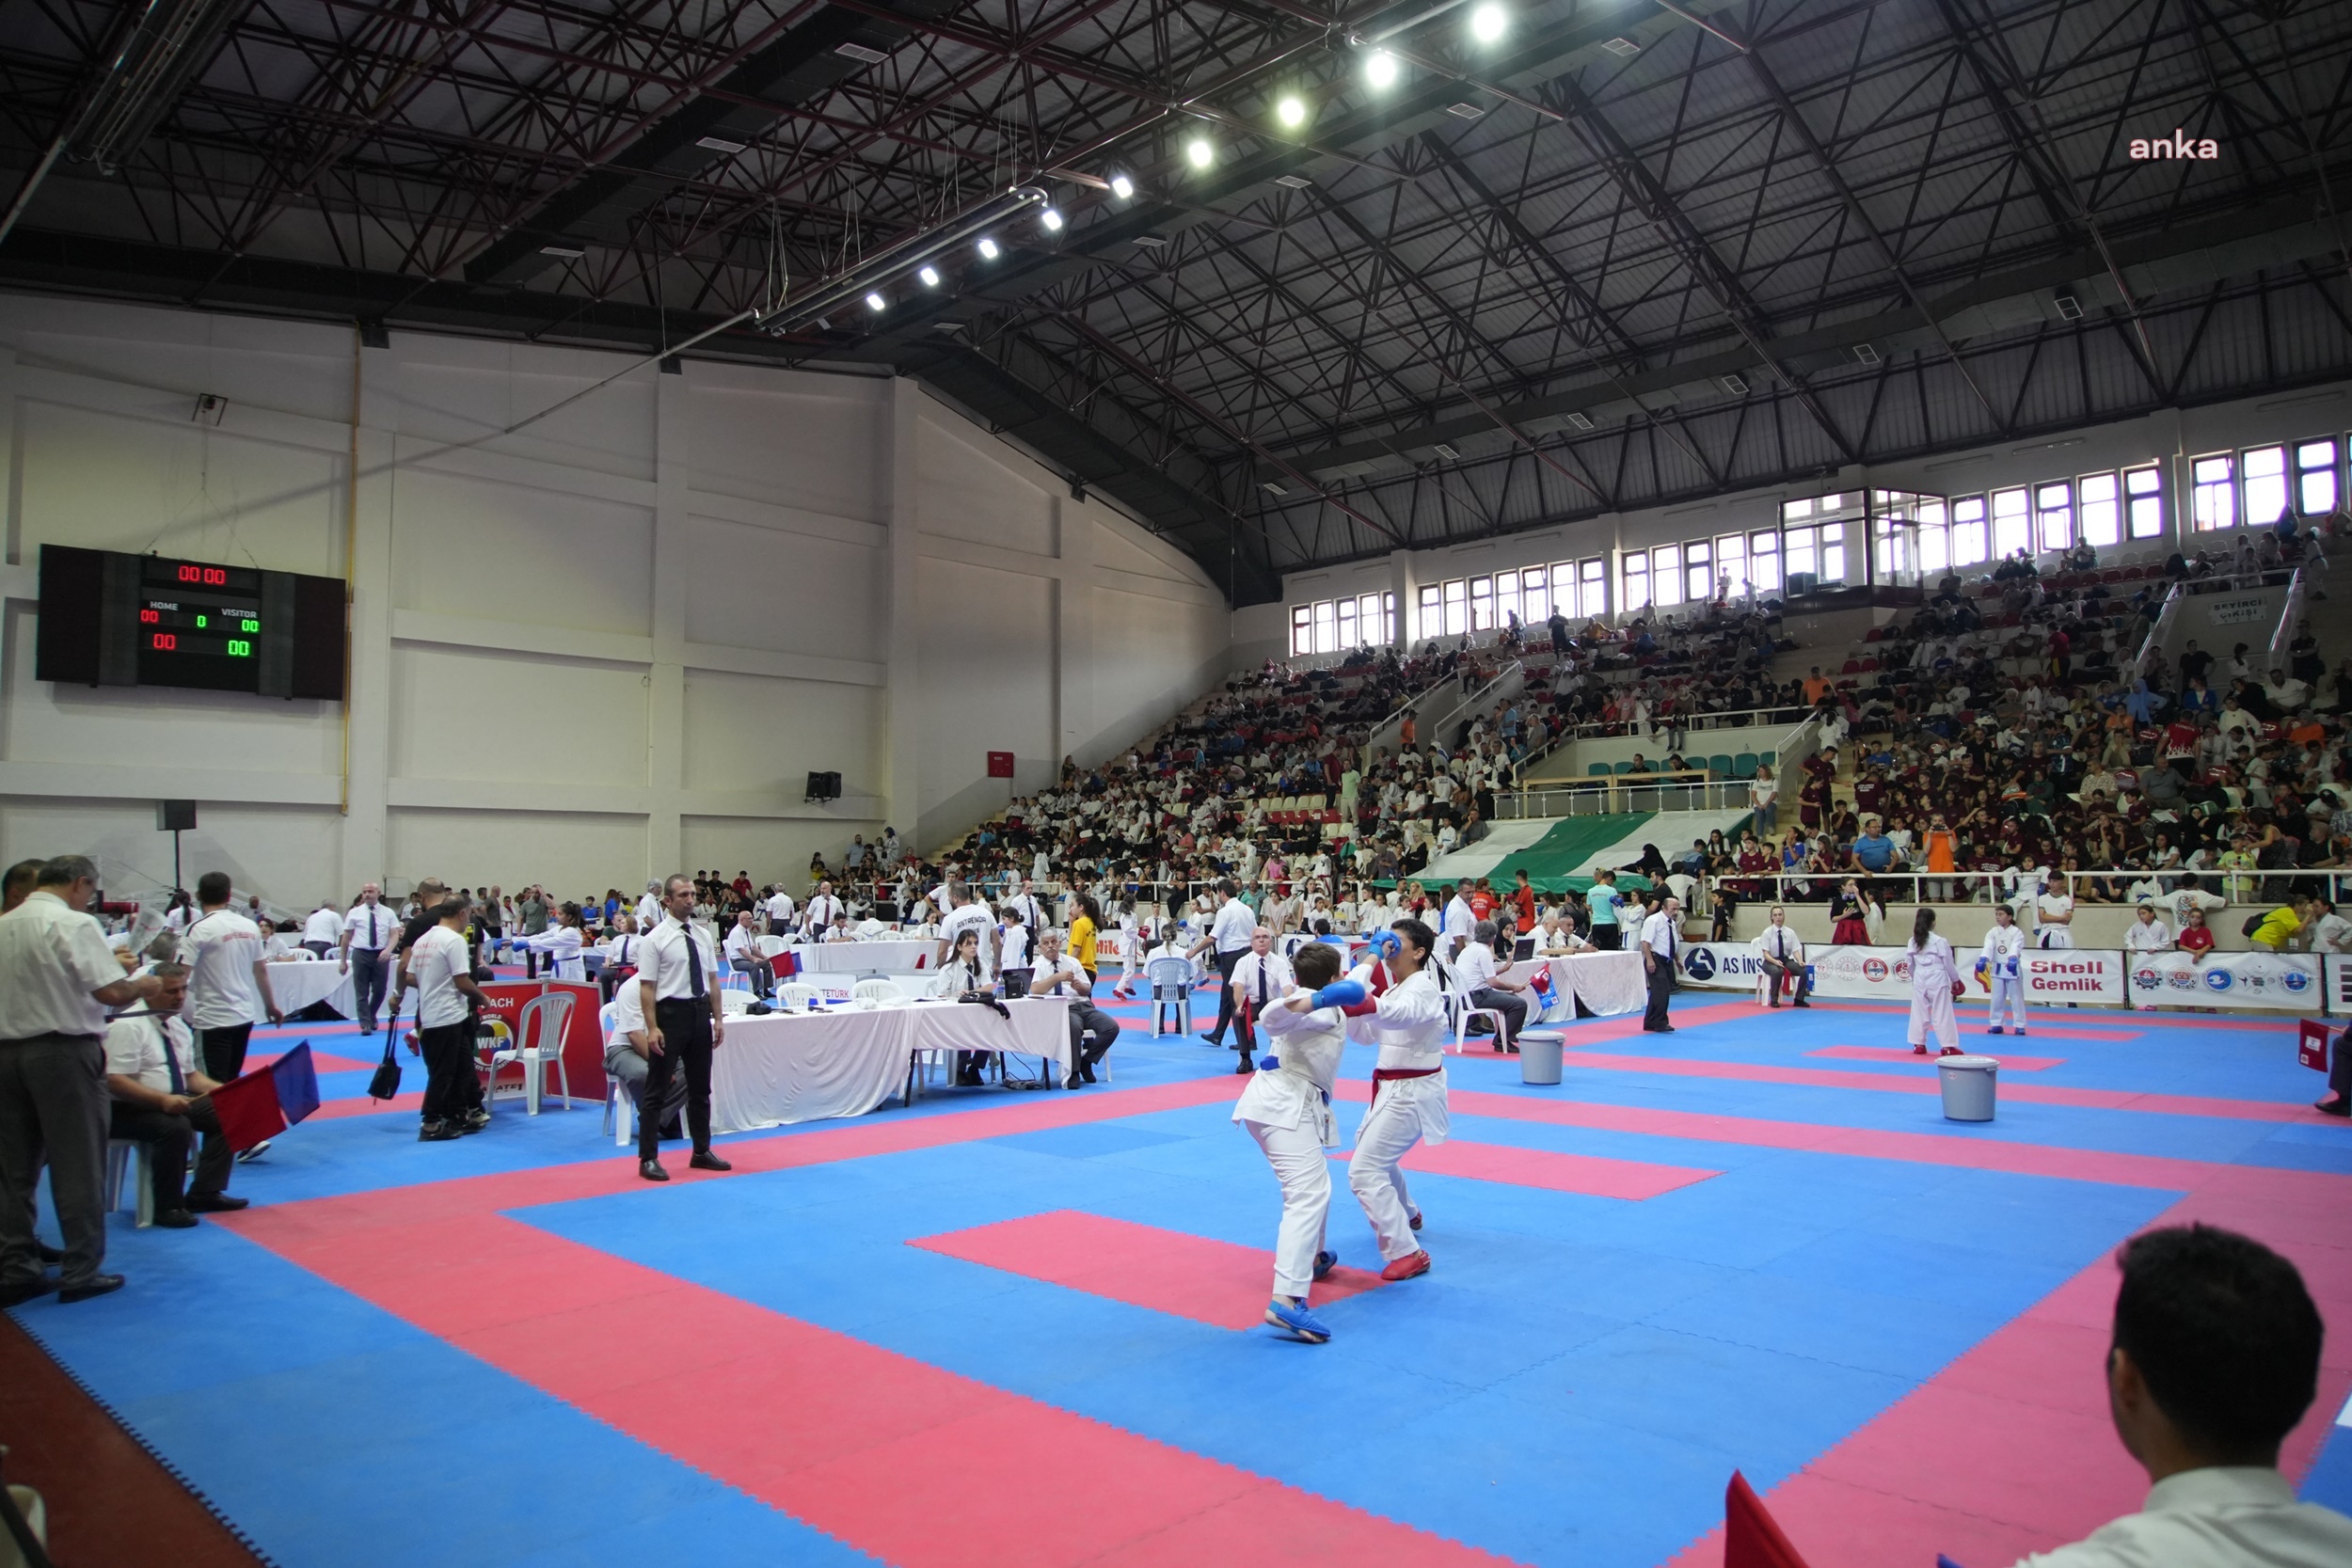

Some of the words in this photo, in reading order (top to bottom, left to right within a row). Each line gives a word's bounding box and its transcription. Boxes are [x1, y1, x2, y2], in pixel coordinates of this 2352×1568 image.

[150, 600, 179, 611] HOME
[140, 610, 159, 623] 00
[221, 608, 258, 619] VISITOR
[197, 615, 207, 627] 0
[241, 619, 259, 632] 00
[153, 633, 176, 649] 00
[228, 640, 249, 656] 00
[1723, 957, 1740, 974] AS
[2030, 960, 2104, 974] Shell
[2031, 976, 2104, 991] Gemlik
[489, 997, 515, 1008] ACH
[477, 1036, 505, 1049] WKF
